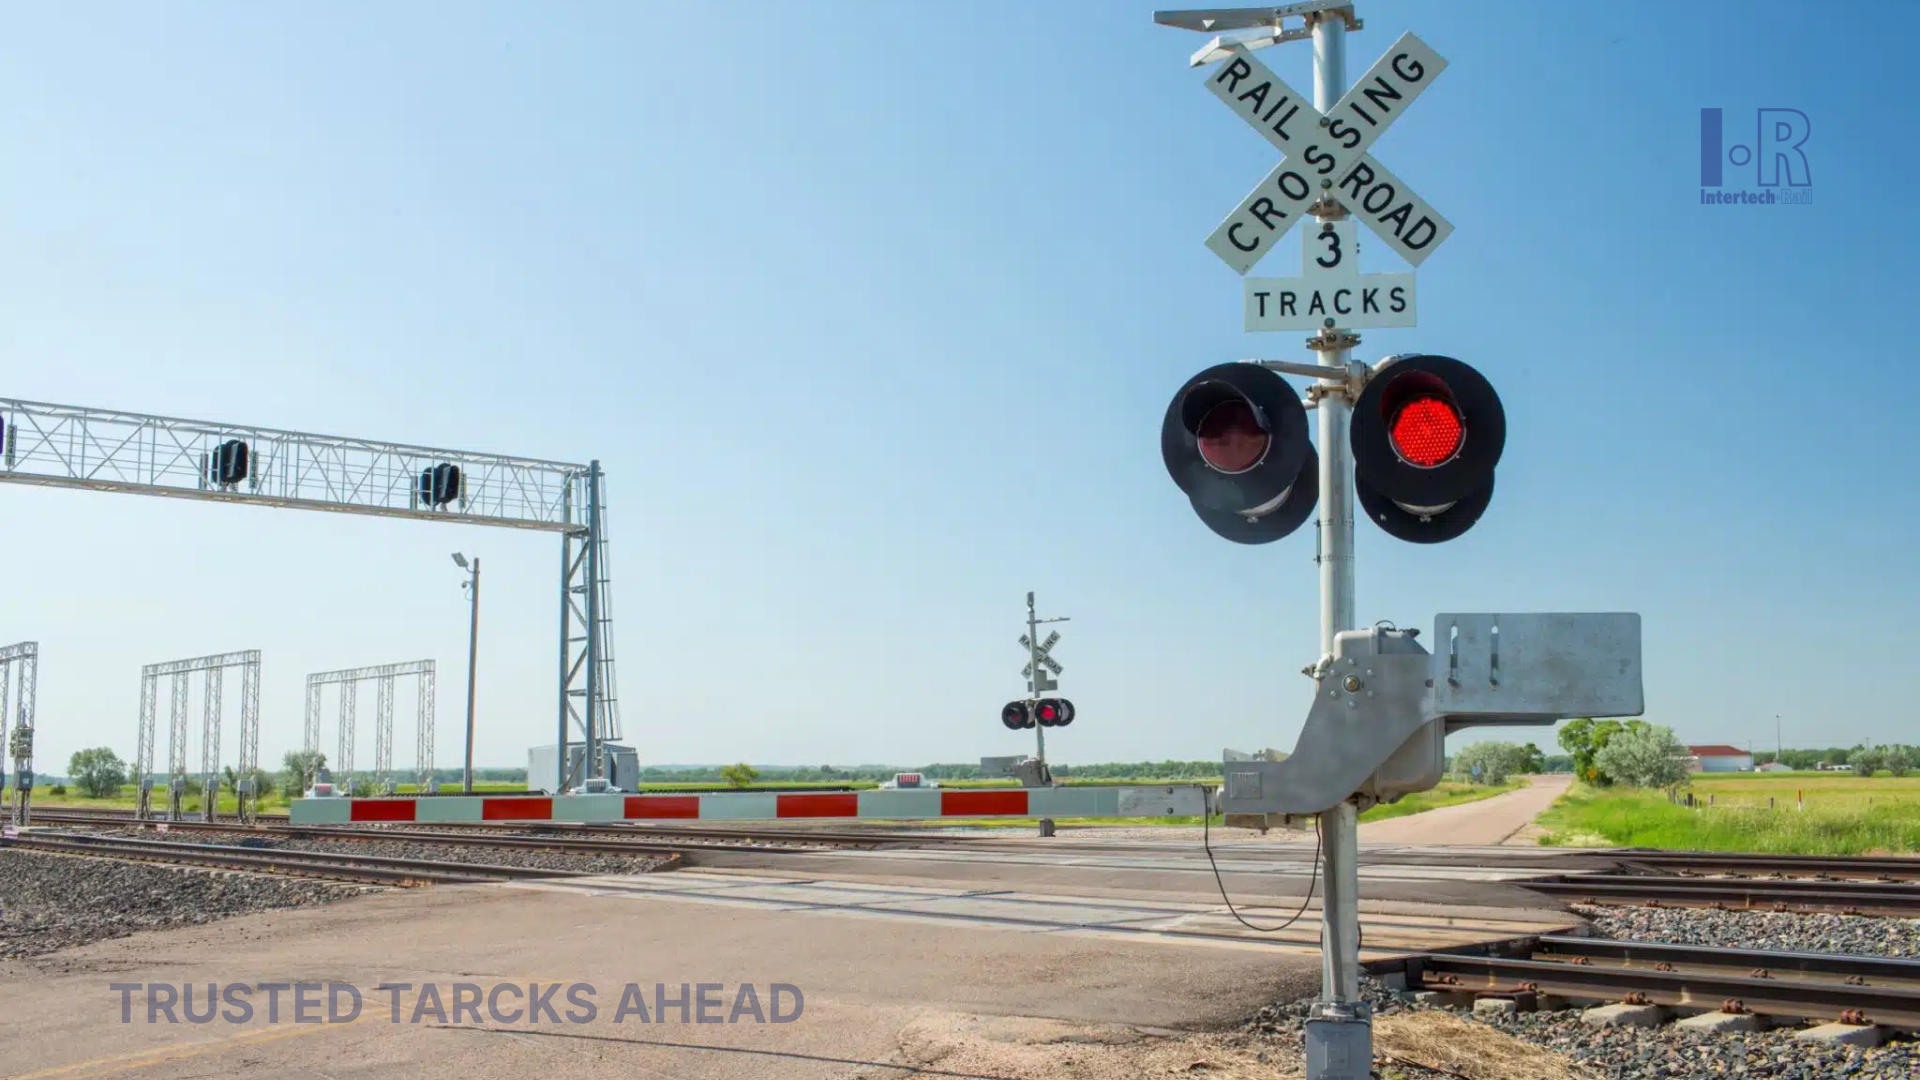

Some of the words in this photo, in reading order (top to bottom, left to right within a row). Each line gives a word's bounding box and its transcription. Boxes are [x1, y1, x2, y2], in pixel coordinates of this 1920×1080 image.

[1216, 56, 1299, 142] RAIL
[1338, 162, 1437, 251] ROAD
[1227, 53, 1425, 252] CROSSING
[1254, 286, 1407, 318] TRACKS
[1316, 230, 1342, 269] 3
